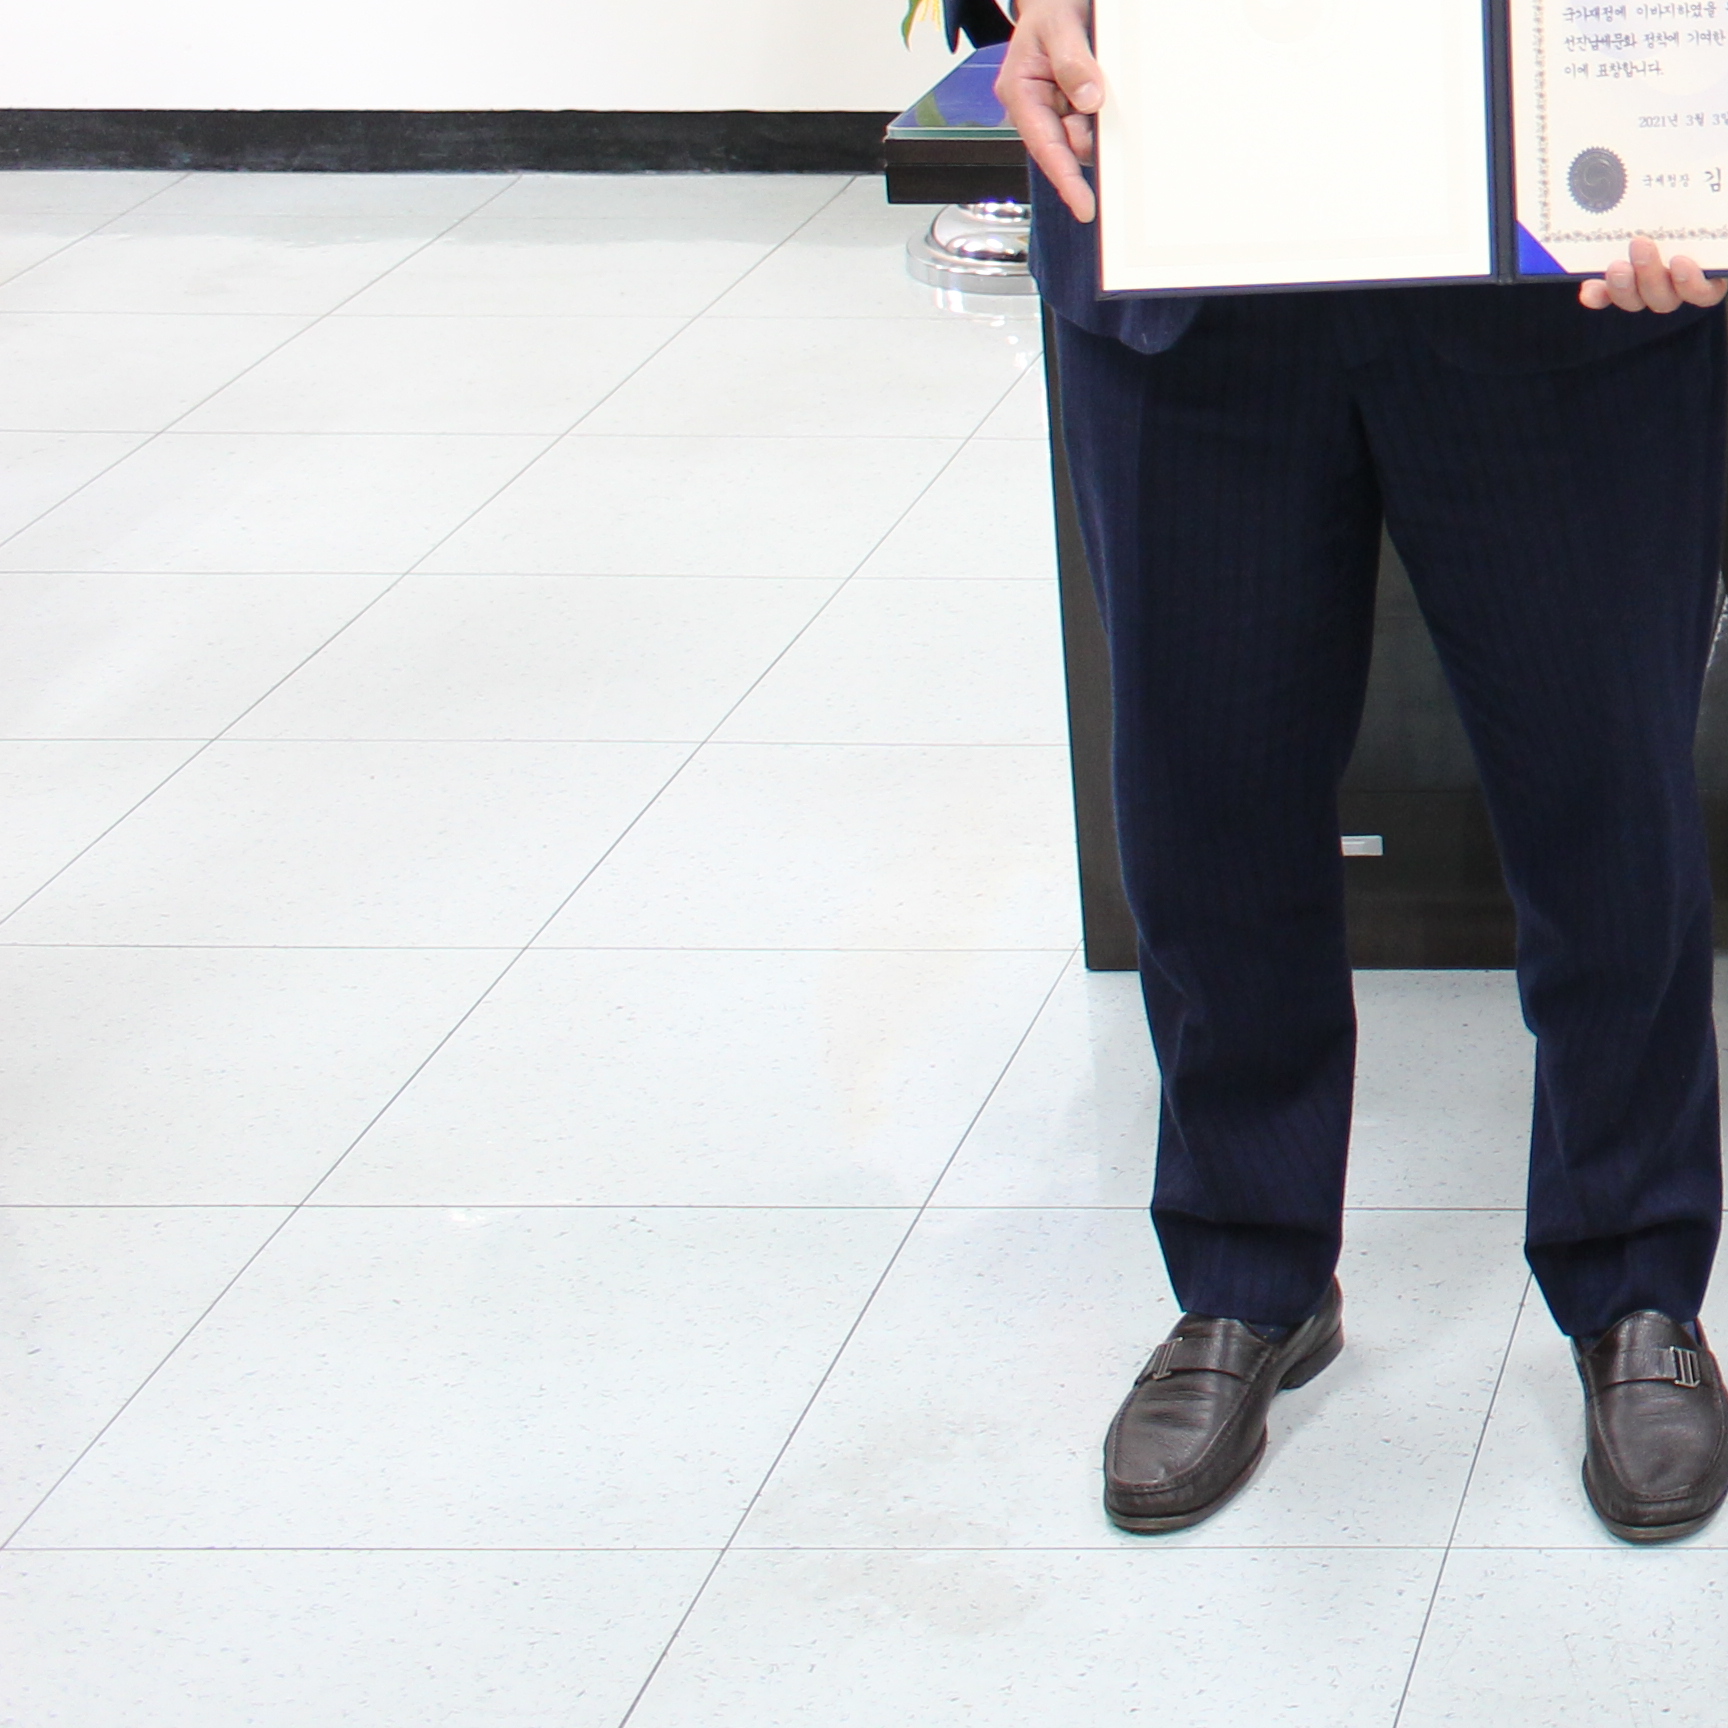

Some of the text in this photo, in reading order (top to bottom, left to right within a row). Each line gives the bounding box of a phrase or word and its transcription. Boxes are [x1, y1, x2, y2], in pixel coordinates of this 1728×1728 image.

[1562, 4, 1627, 23] 국가재정에
[1636, 0, 1717, 20] 이바지하였을
[1564, 32, 1638, 53] 선진납세문화
[1644, 30, 1680, 50] 정착에
[1687, 28, 1726, 47] 기여한
[1564, 62, 1589, 78] 이에
[1638, 112, 1679, 129] 2021년
[1686, 112, 1705, 127] 3월
[1642, 173, 1690, 188] 국세청장
